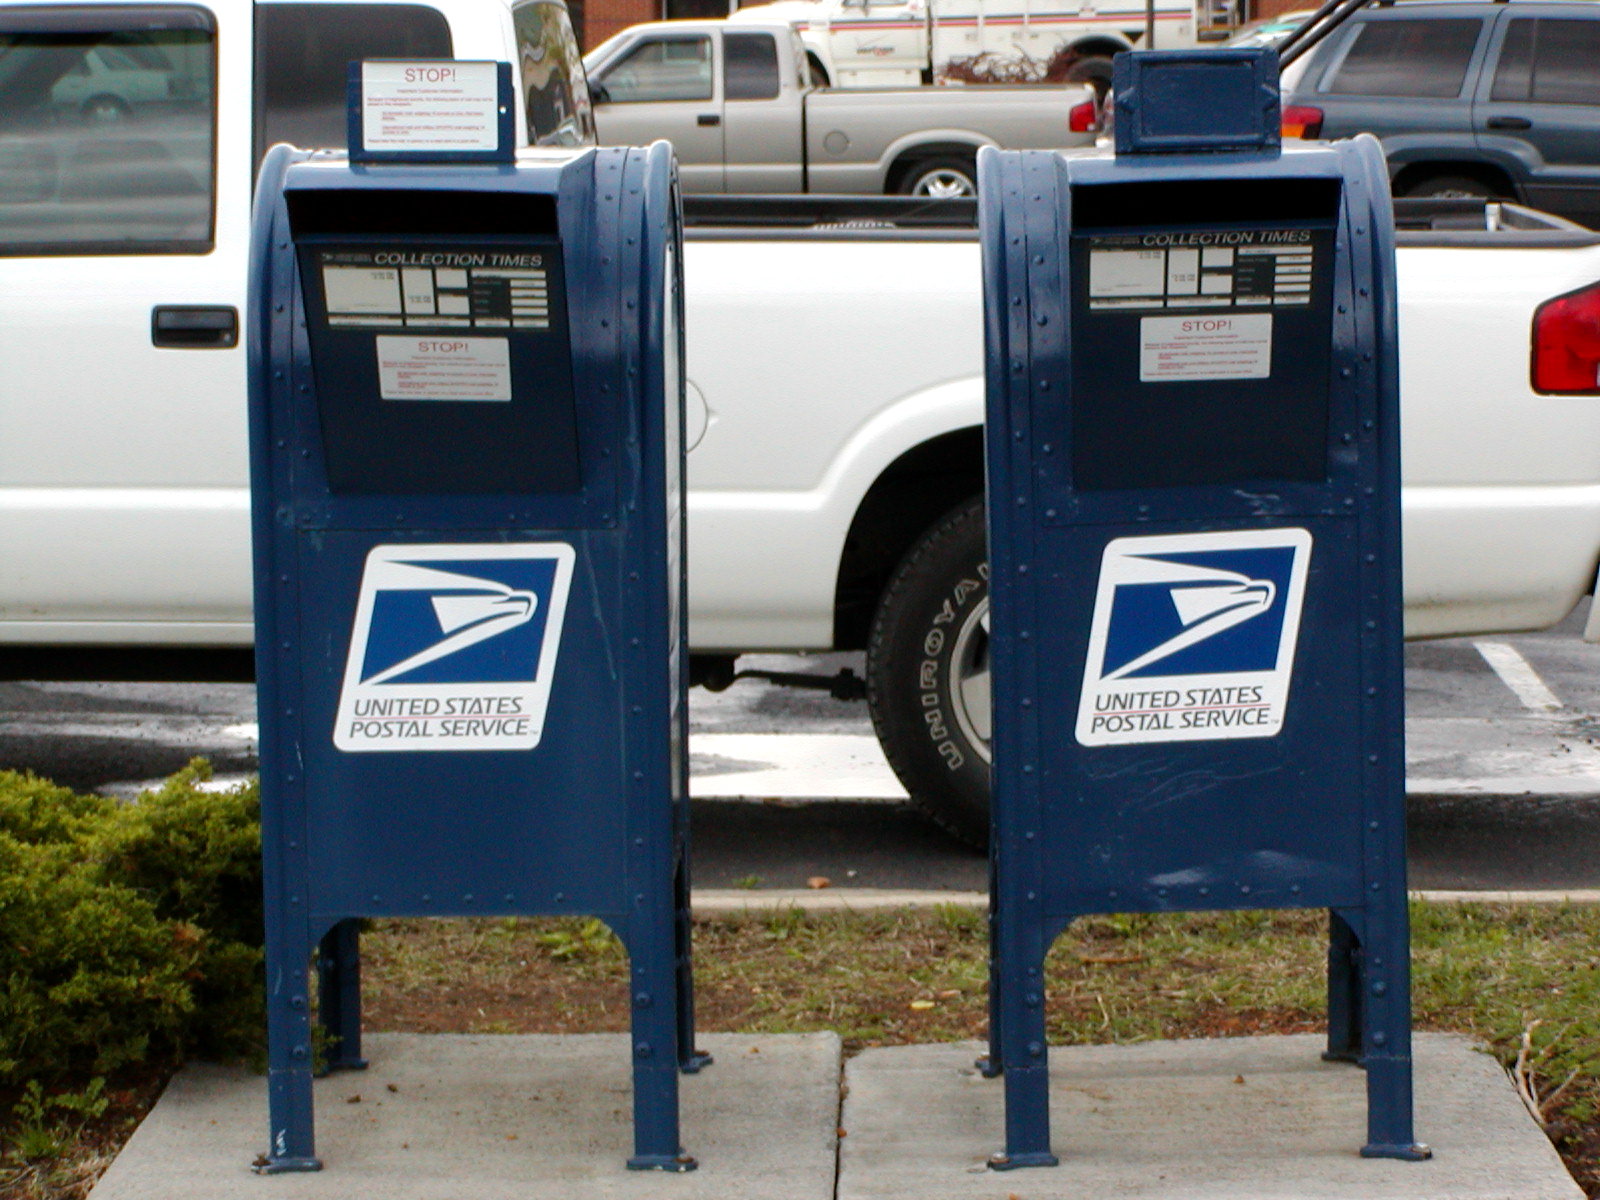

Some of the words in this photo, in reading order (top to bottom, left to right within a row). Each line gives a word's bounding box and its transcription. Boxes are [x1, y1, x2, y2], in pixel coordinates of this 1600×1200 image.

[404, 68, 456, 83] STOP!
[1142, 231, 1254, 246] COLLECTION
[1259, 230, 1311, 243] TIMES
[374, 252, 486, 266] COLLECTION
[490, 254, 543, 267] TIMES
[1181, 320, 1232, 332] STOP!
[418, 341, 469, 353] STOP!
[354, 697, 440, 717] UNITED
[444, 696, 523, 715] STATES
[1095, 690, 1180, 712] UNITED
[1184, 685, 1263, 707] STATES
[349, 719, 434, 739] POSTAL
[438, 718, 530, 738] SERVICE
[1091, 713, 1174, 734] POSTAL
[1179, 707, 1271, 729] SERVICE
